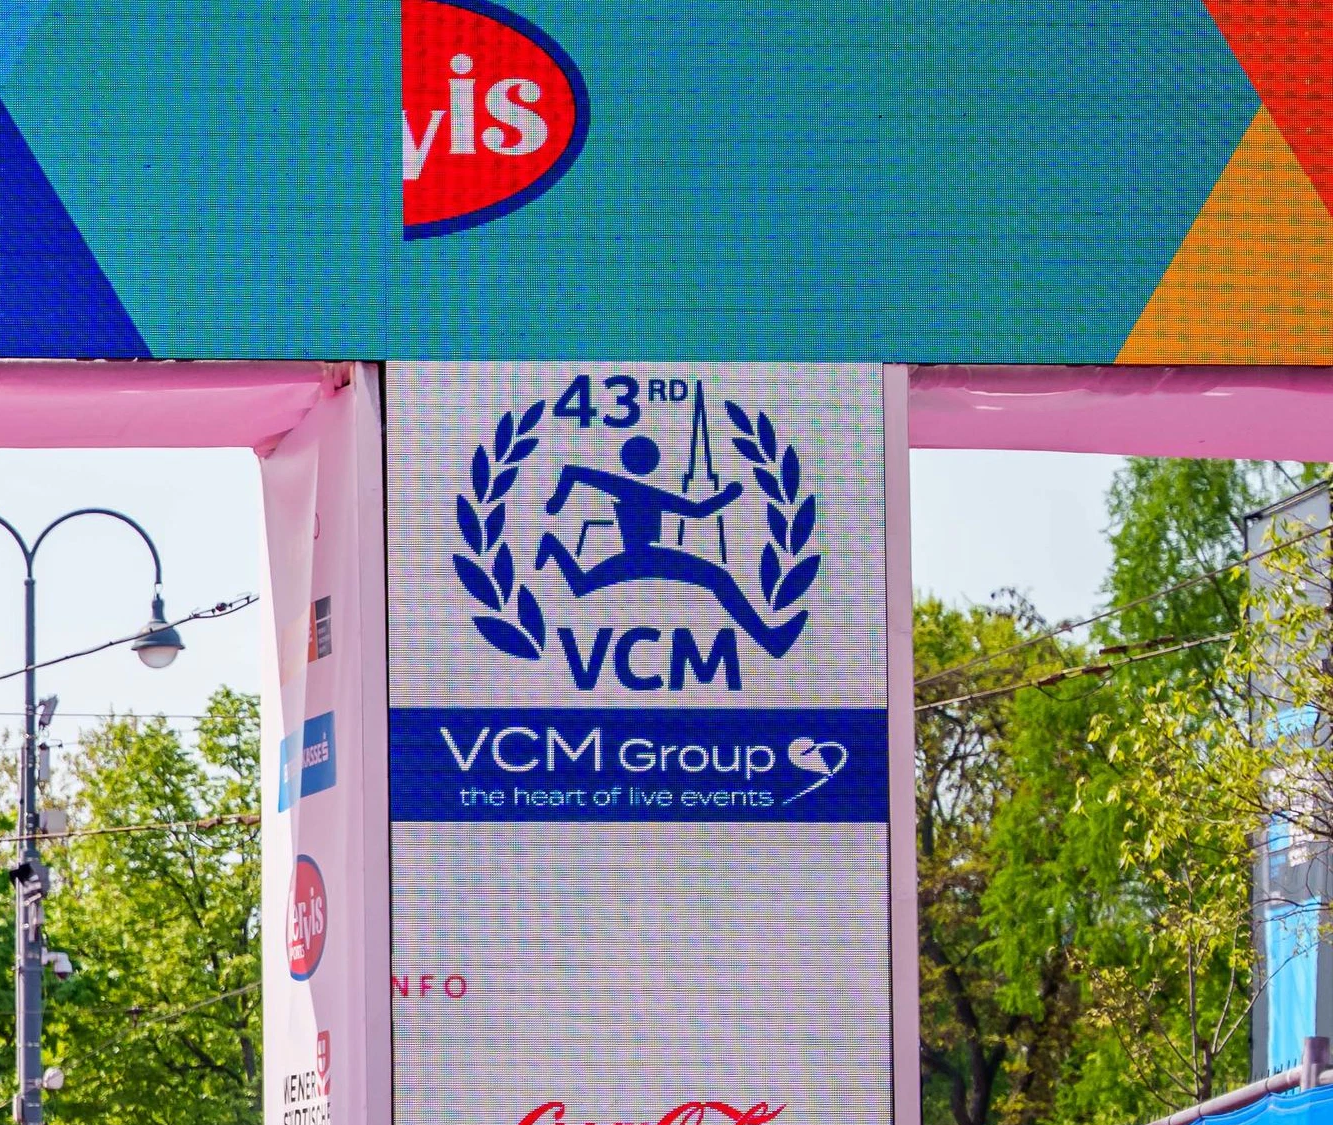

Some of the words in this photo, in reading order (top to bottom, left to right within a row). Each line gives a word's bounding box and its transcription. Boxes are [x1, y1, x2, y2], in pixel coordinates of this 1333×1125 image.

[557, 627, 744, 691] VCM
[439, 726, 603, 772] VCM
[618, 737, 776, 781] Group
[460, 786, 508, 807] the
[513, 786, 589, 807] heart
[594, 786, 623, 807] of
[628, 786, 676, 807] live
[681, 786, 775, 807] events
